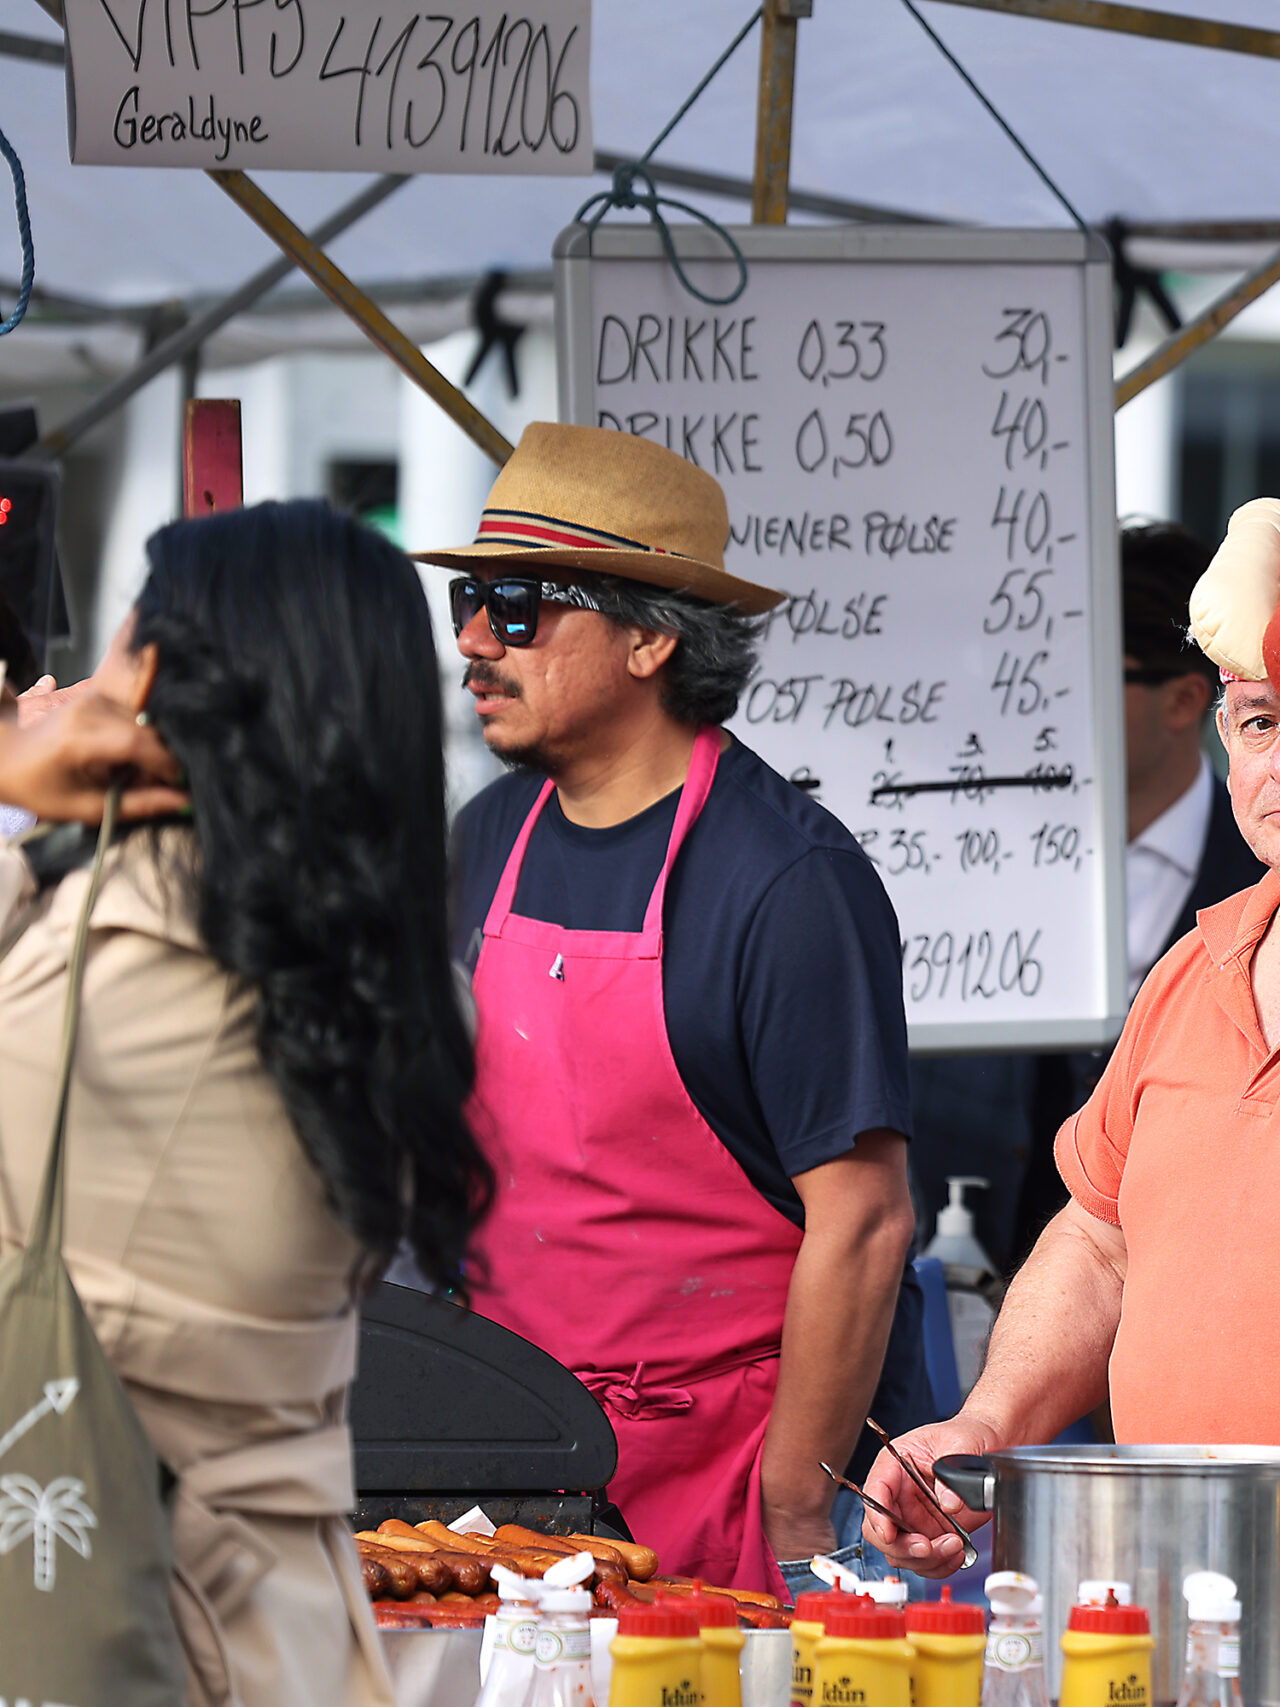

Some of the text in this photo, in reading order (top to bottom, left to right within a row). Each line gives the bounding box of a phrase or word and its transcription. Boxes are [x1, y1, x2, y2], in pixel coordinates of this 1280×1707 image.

[113, 86, 269, 160] Geraldyne
[319, 14, 579, 156] 41391206
[597, 308, 1069, 387] DRIKKE 0,33 30,-
[598, 392, 1069, 478] IKKE 0,50 40,-
[863, 510, 957, 560] PØLSE
[991, 487, 1077, 563] 40,-
[983, 569, 1084, 638] 55,-
[823, 678, 948, 731] PØLSE
[991, 651, 1071, 717] 45,-
[955, 828, 1013, 874] 100,-
